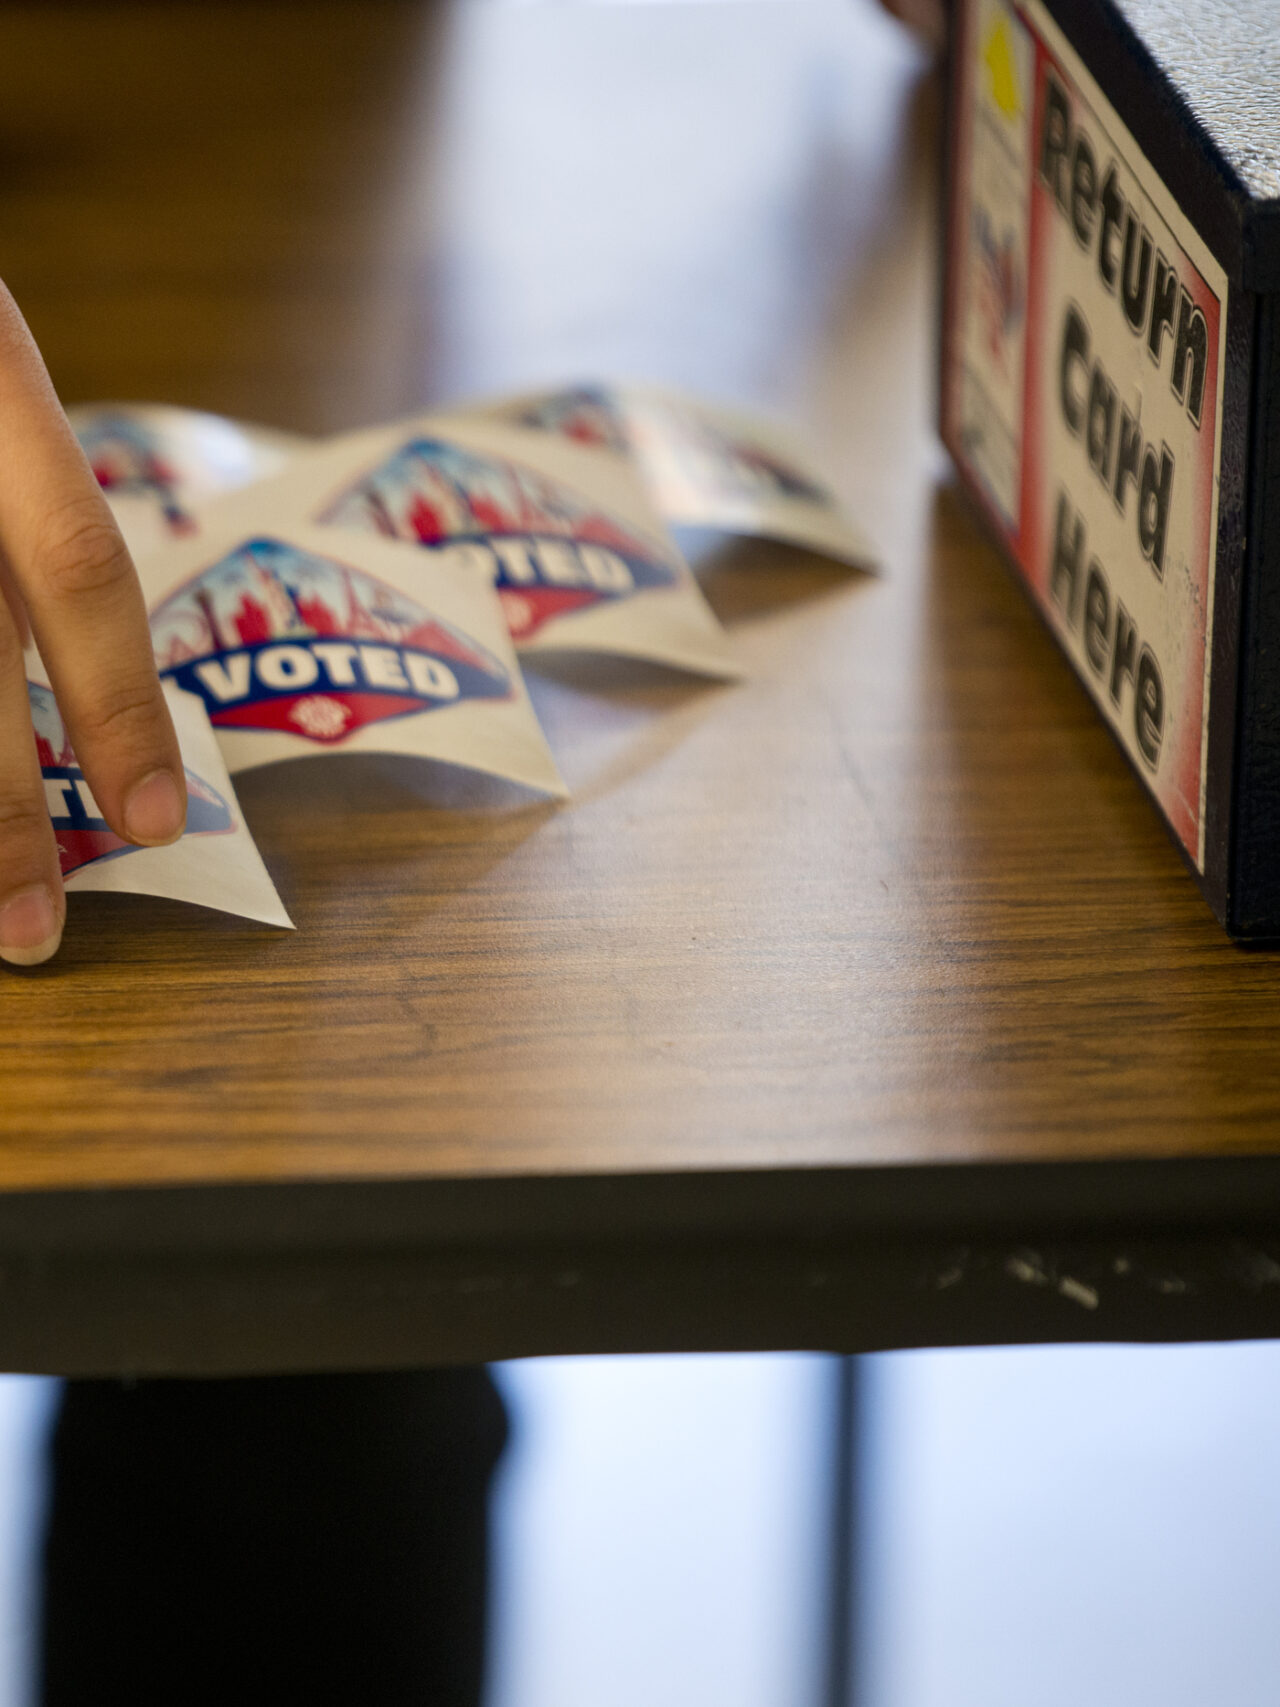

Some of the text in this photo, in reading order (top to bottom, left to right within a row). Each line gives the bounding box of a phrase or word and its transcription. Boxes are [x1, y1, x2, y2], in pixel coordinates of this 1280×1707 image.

[1040, 76, 1209, 432] Return
[1061, 298, 1176, 584] Card
[194, 643, 461, 704] VOTED
[1050, 488, 1166, 774] Here
